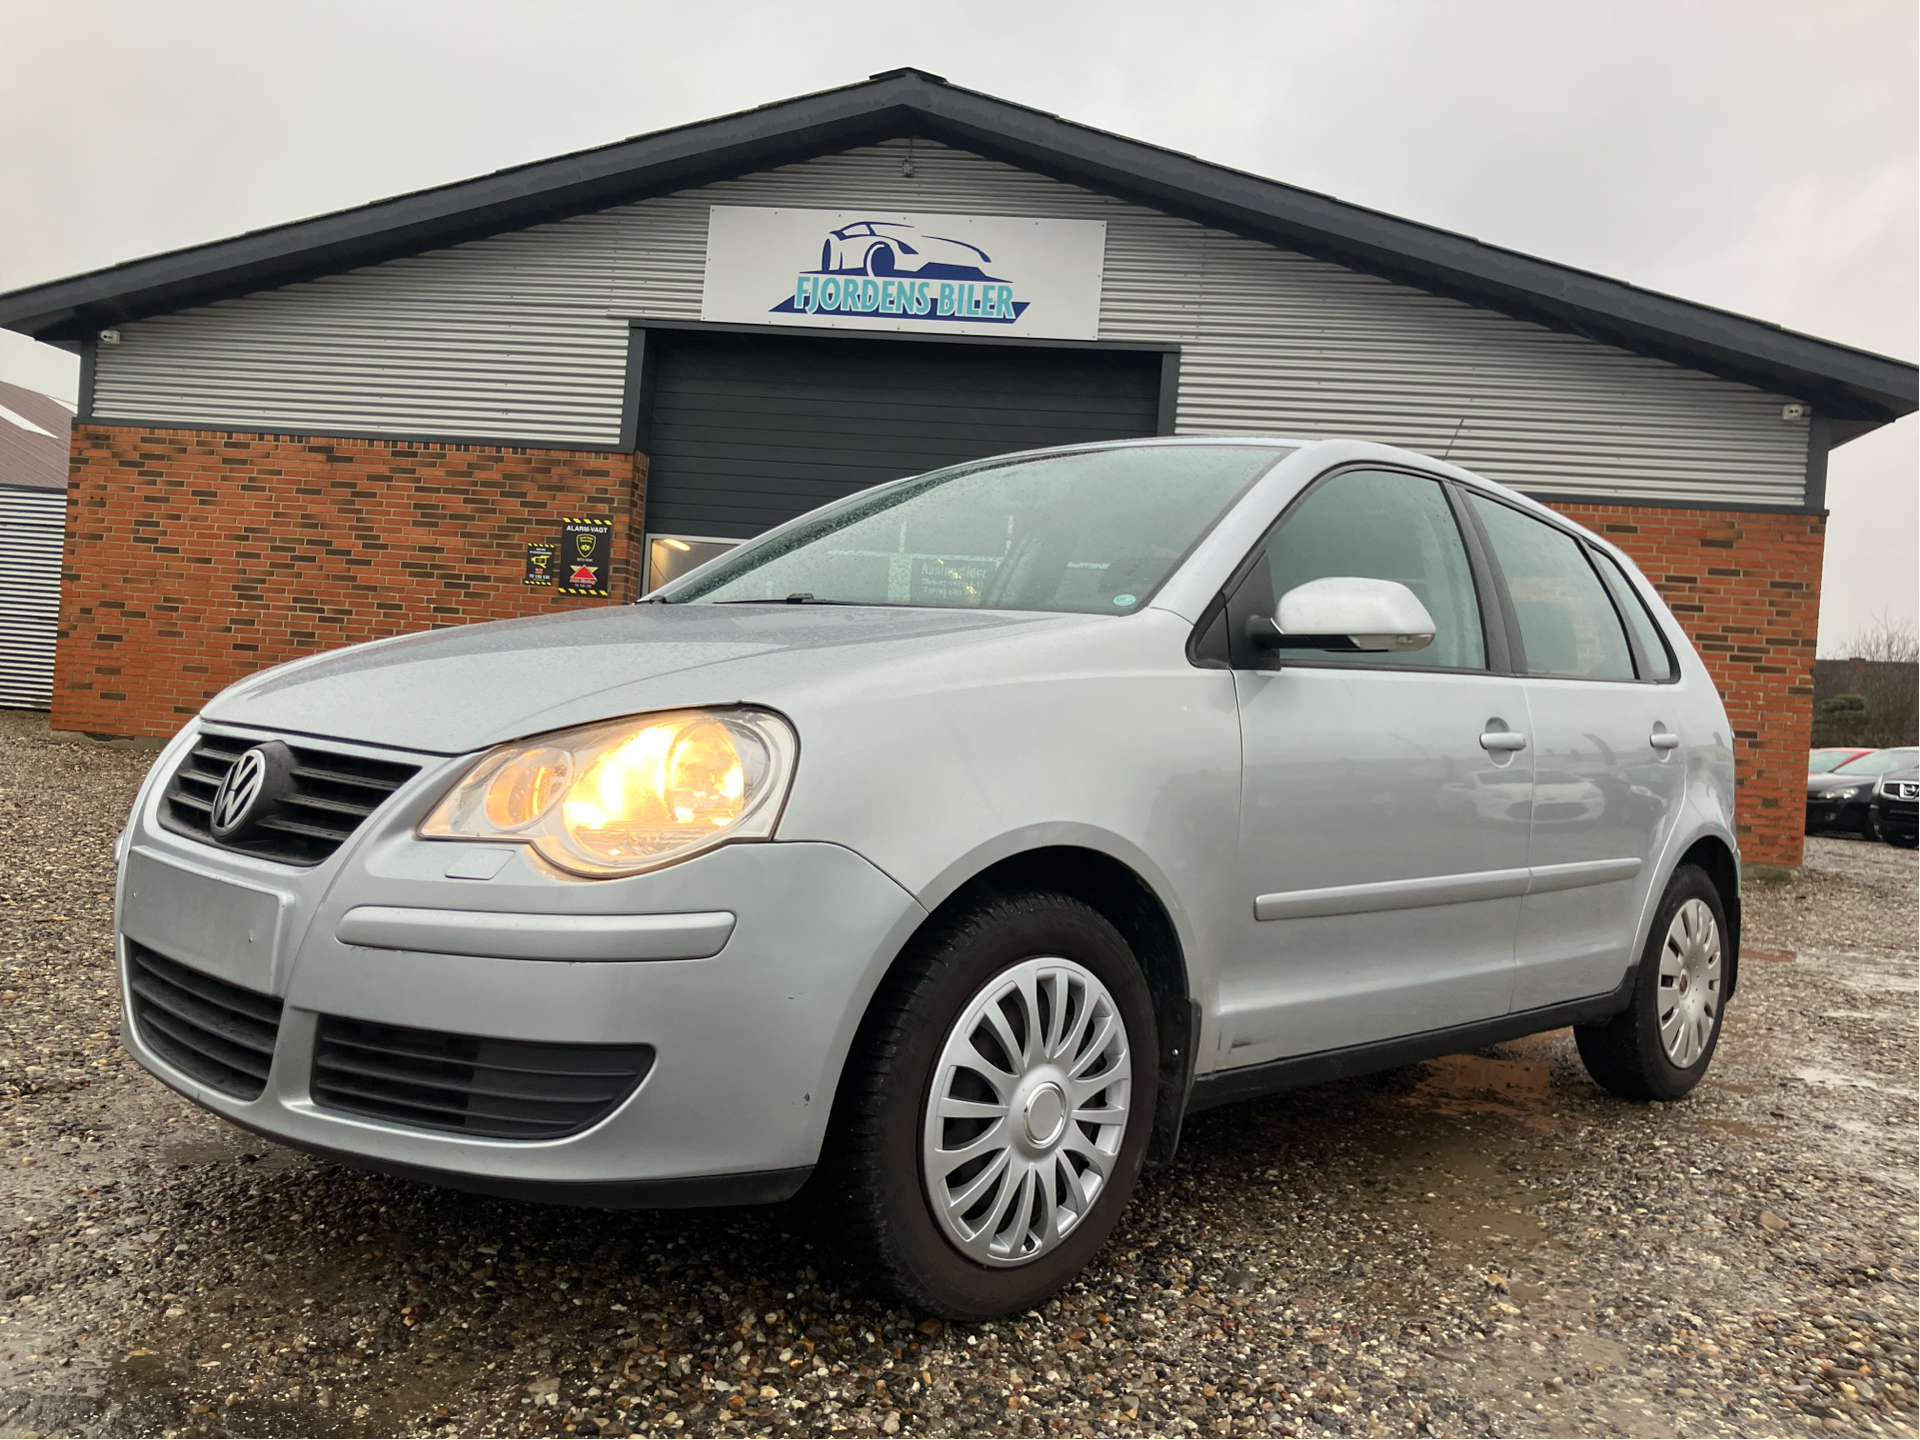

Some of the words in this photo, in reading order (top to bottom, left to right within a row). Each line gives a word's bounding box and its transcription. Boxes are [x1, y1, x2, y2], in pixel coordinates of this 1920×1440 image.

[794, 275, 932, 315] FJORDENS
[937, 281, 1017, 320] BILER
[566, 525, 608, 533] ALARM-VAGT
